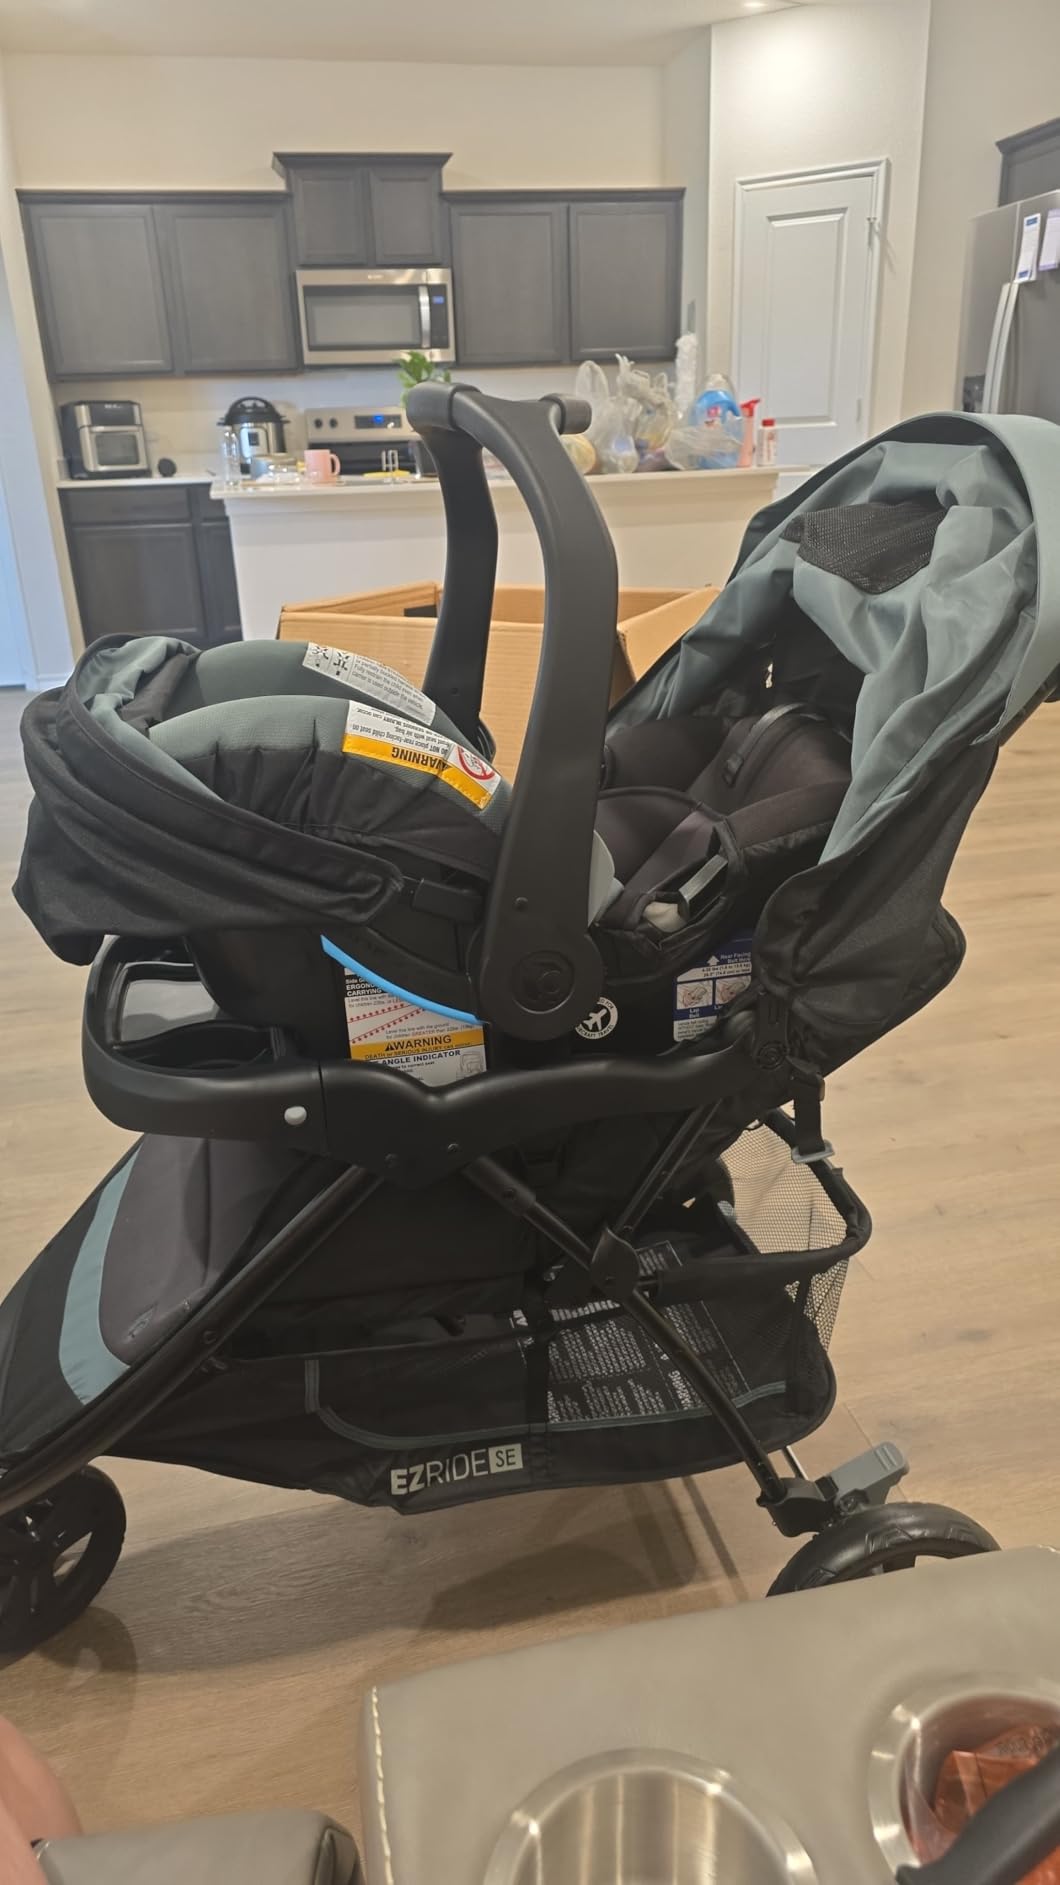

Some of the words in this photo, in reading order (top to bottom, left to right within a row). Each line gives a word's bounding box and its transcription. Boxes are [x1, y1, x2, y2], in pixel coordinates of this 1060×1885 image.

[353, 664, 365, 674] Fully
[372, 680, 384, 688] used
[360, 725, 371, 733] seat
[372, 729, 385, 737] child
[386, 732, 415, 745] rear-facing
[415, 740, 429, 749] place
[429, 745, 441, 754] NOT
[391, 747, 447, 772] WARNING
[346, 988, 382, 997] CARRYING
[605, 1000, 614, 1010] FOR
[434, 1022, 449, 1030] ground
[598, 1024, 614, 1037] TRAVEL
[393, 1034, 452, 1051] WARNING
[364, 1052, 386, 1060] DEATH
[394, 1049, 420, 1057] SERIOUS
[421, 1046, 443, 1055] INJURY
[382, 1056, 411, 1065] ANGLE
[413, 1049, 461, 1062] INDICATOR
[495, 1448, 516, 1468] SE
